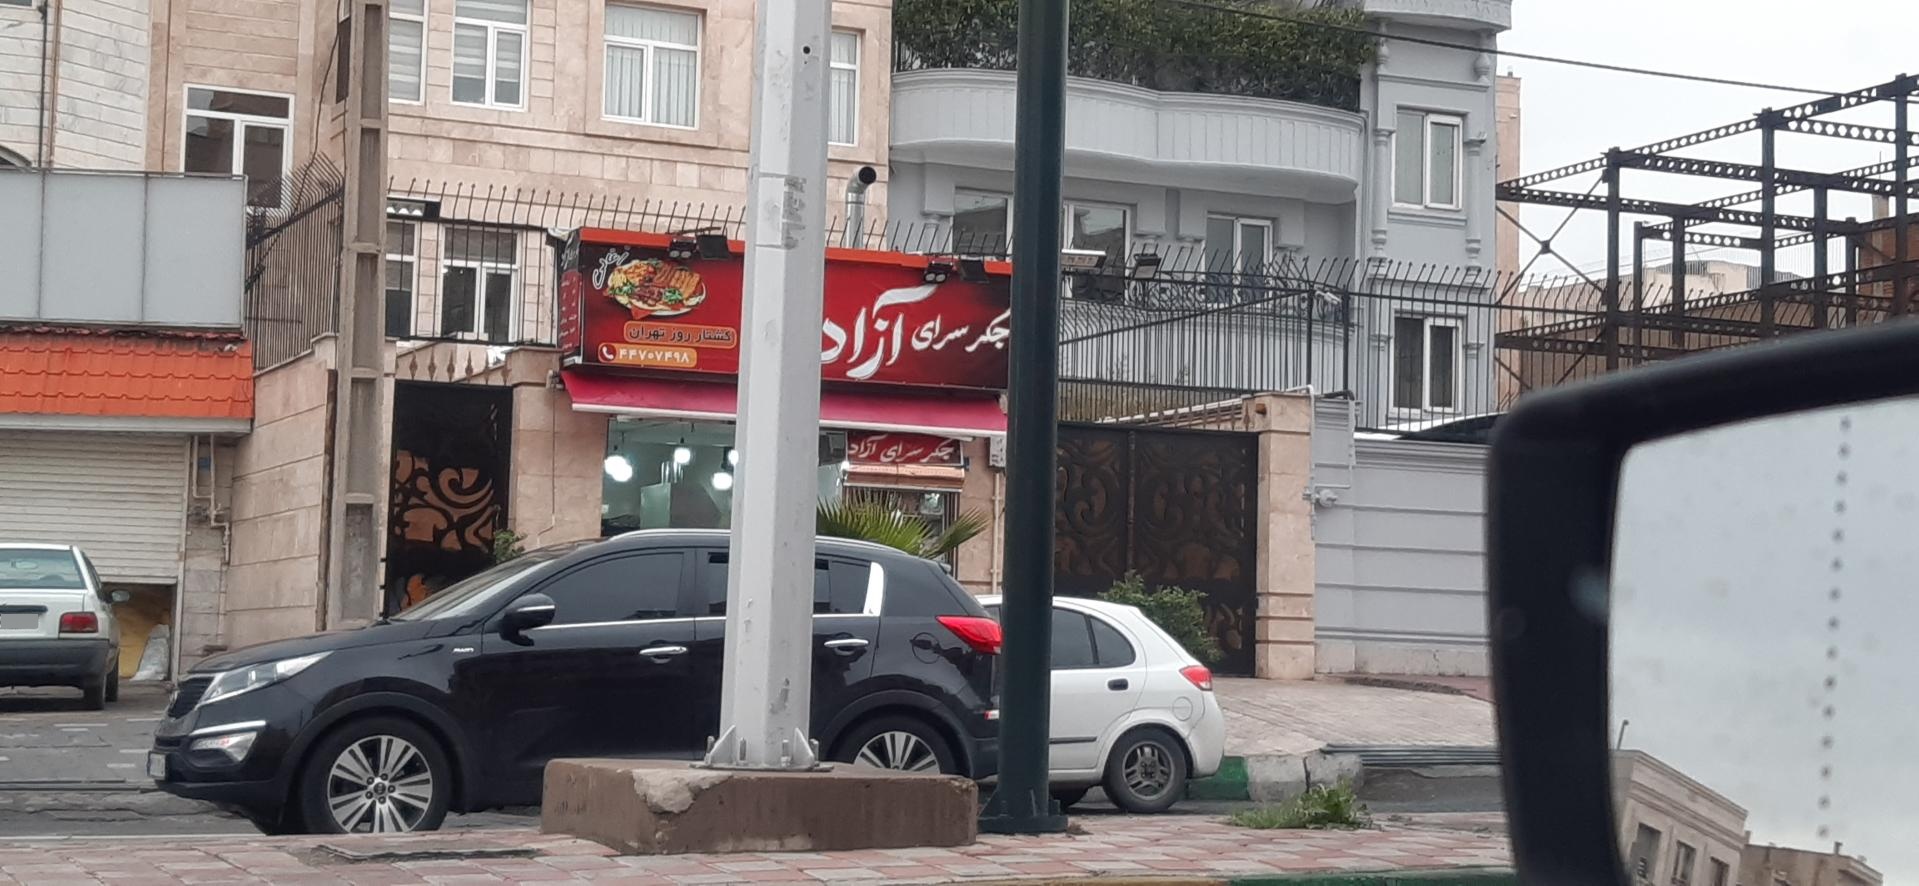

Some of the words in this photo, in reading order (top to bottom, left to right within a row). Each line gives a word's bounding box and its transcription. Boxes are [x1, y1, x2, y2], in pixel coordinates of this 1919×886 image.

[629, 324, 666, 342] تهران
[669, 327, 691, 343] روز
[695, 328, 732, 343] کشتار
[821, 283, 939, 379] آزاد
[911, 314, 970, 351] سرای
[619, 348, 690, 364] ۴۴۷۰۷۴۹۸
[848, 433, 888, 458] آزاد
[880, 441, 924, 463] سرای
